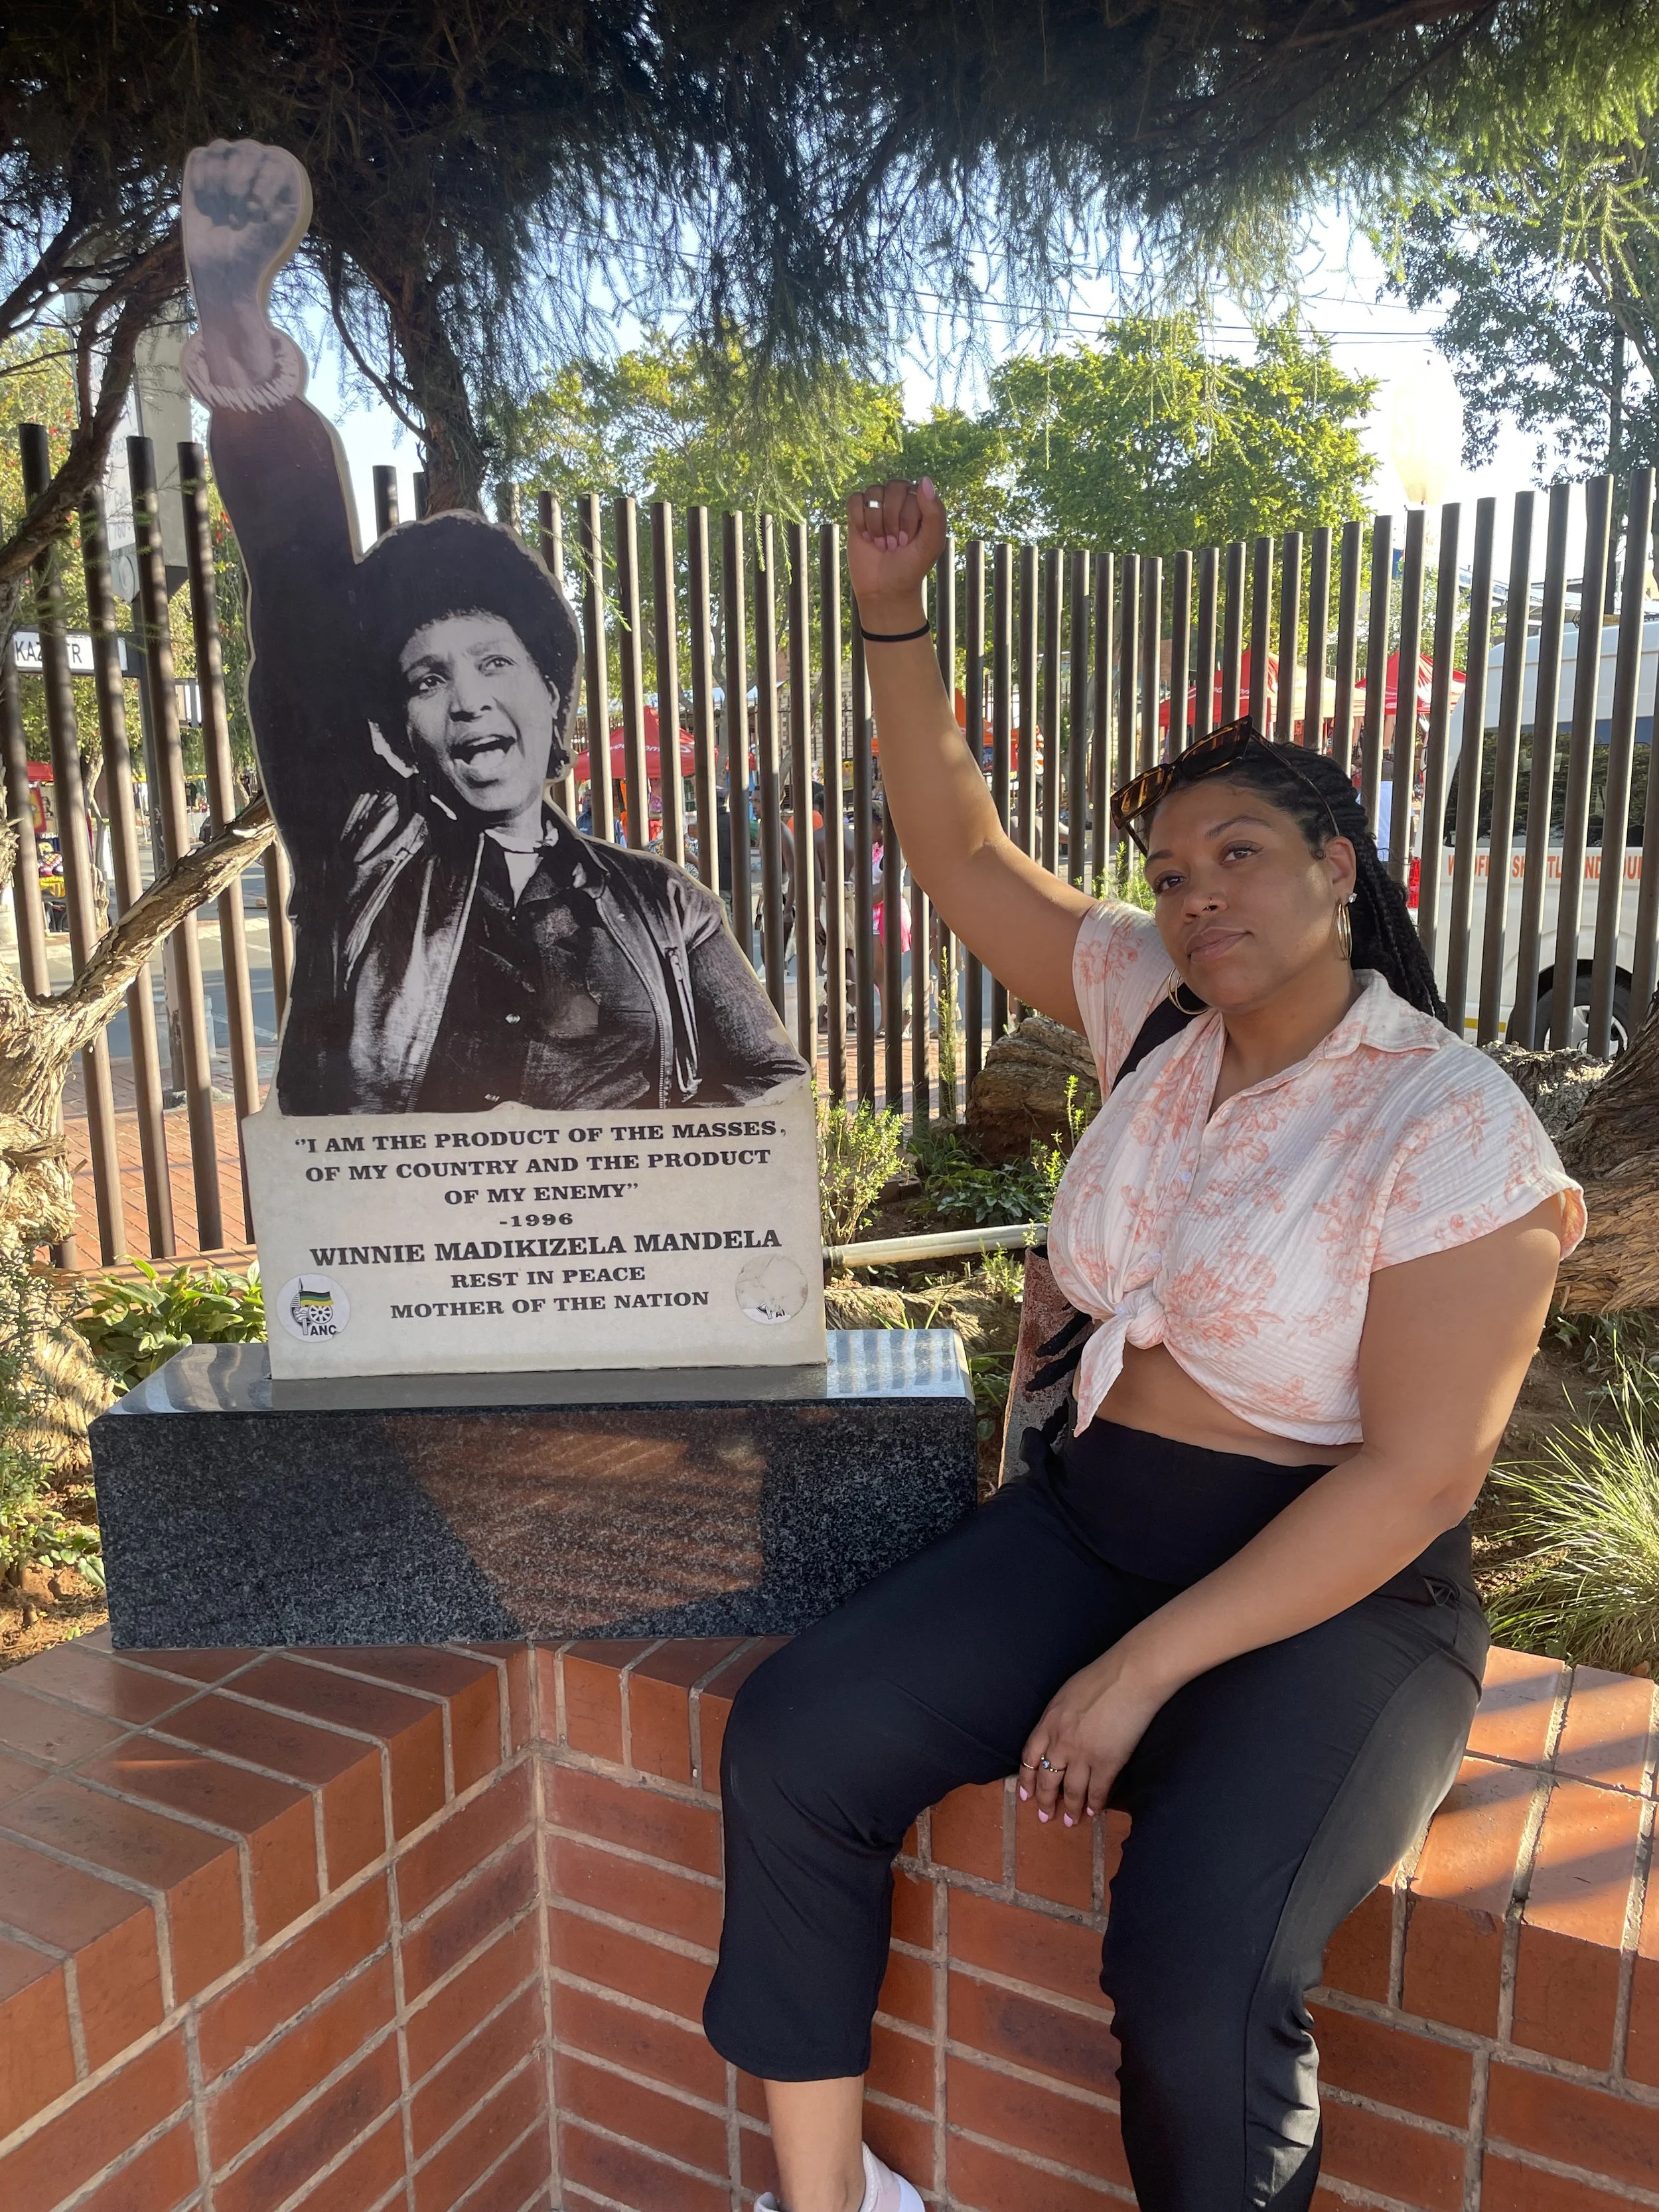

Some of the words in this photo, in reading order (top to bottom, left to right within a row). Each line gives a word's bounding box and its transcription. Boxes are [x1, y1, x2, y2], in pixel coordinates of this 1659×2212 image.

[325, 1137, 365, 1152] AM
[372, 1135, 426, 1150] THE
[435, 1130, 559, 1147] PRODUCT
[569, 1128, 603, 1142] OF
[611, 1126, 664, 1141] THE
[672, 1120, 786, 1138] MASSES,
[306, 1167, 340, 1181] OF
[348, 1165, 388, 1180] MY
[396, 1160, 518, 1178] COUNTRY
[526, 1157, 578, 1173] AND
[587, 1155, 639, 1170] THE
[648, 1149, 770, 1168] PRODUCT
[445, 1190, 478, 1205] OF
[487, 1188, 526, 1203] MY
[500, 1213, 573, 1226] -1996
[309, 1244, 425, 1266] WINNIE
[434, 1236, 626, 1261] MADIKIZELA
[634, 1230, 782, 1253] MANDELA
[451, 1272, 518, 1288] REST
[526, 1270, 553, 1285] IN
[562, 1267, 645, 1283] PEACE
[390, 1301, 504, 1318] MOTHER
[512, 1299, 545, 1313] OF
[553, 1296, 605, 1311] THE
[614, 1291, 709, 1309] NATION
[310, 1325, 337, 1336] ANC
